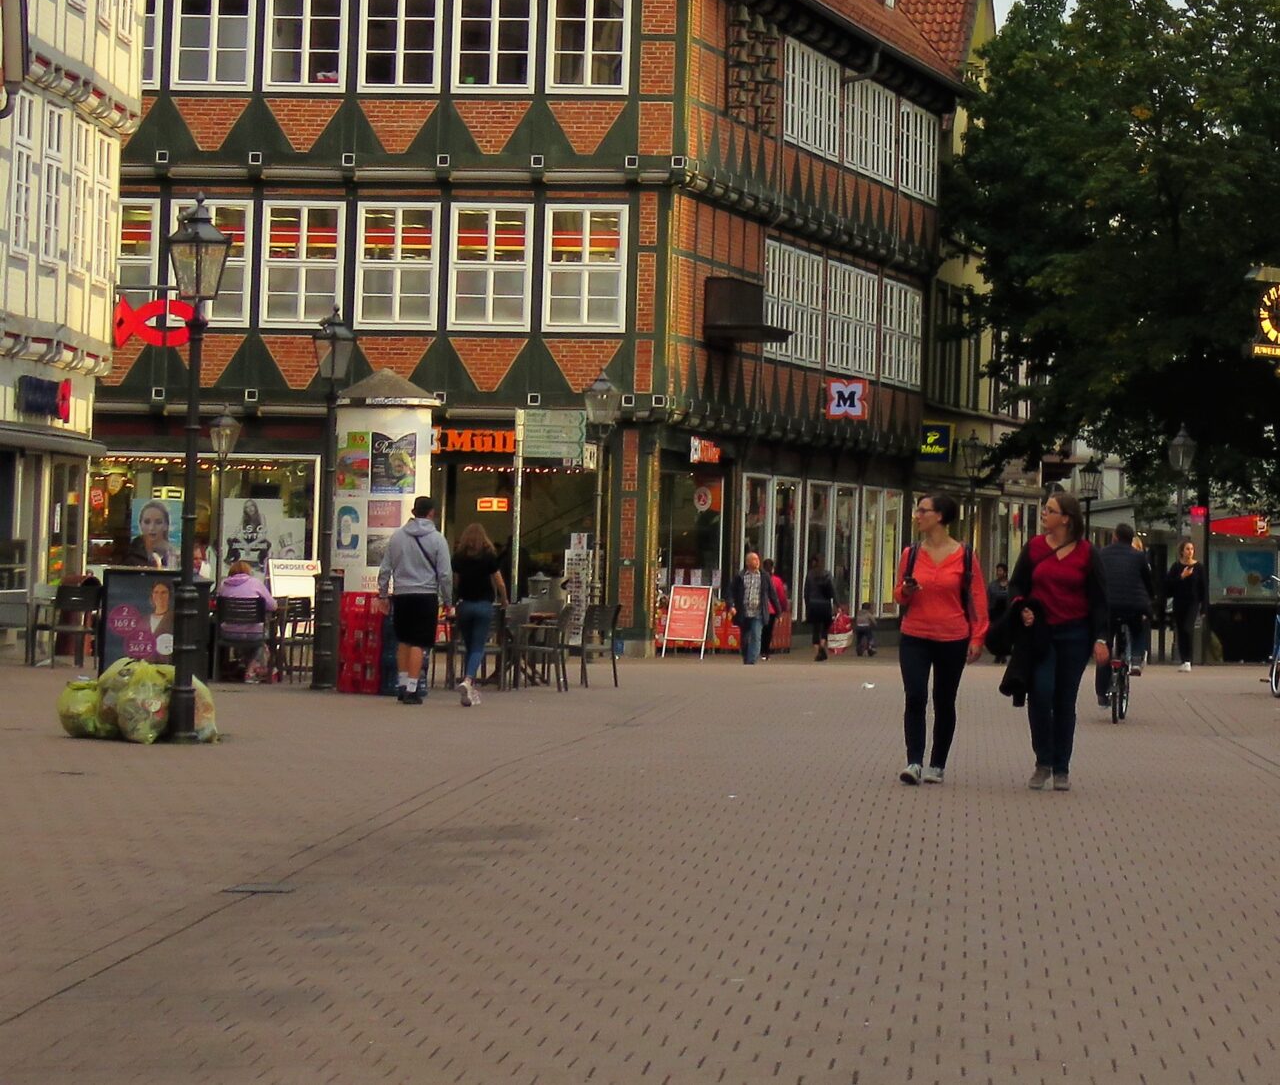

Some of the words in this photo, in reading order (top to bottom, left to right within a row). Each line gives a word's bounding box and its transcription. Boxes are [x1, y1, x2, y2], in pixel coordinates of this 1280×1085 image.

[836, 390, 856, 408] M
[447, 427, 516, 453] Müll
[673, 595, 706, 609] 10%
